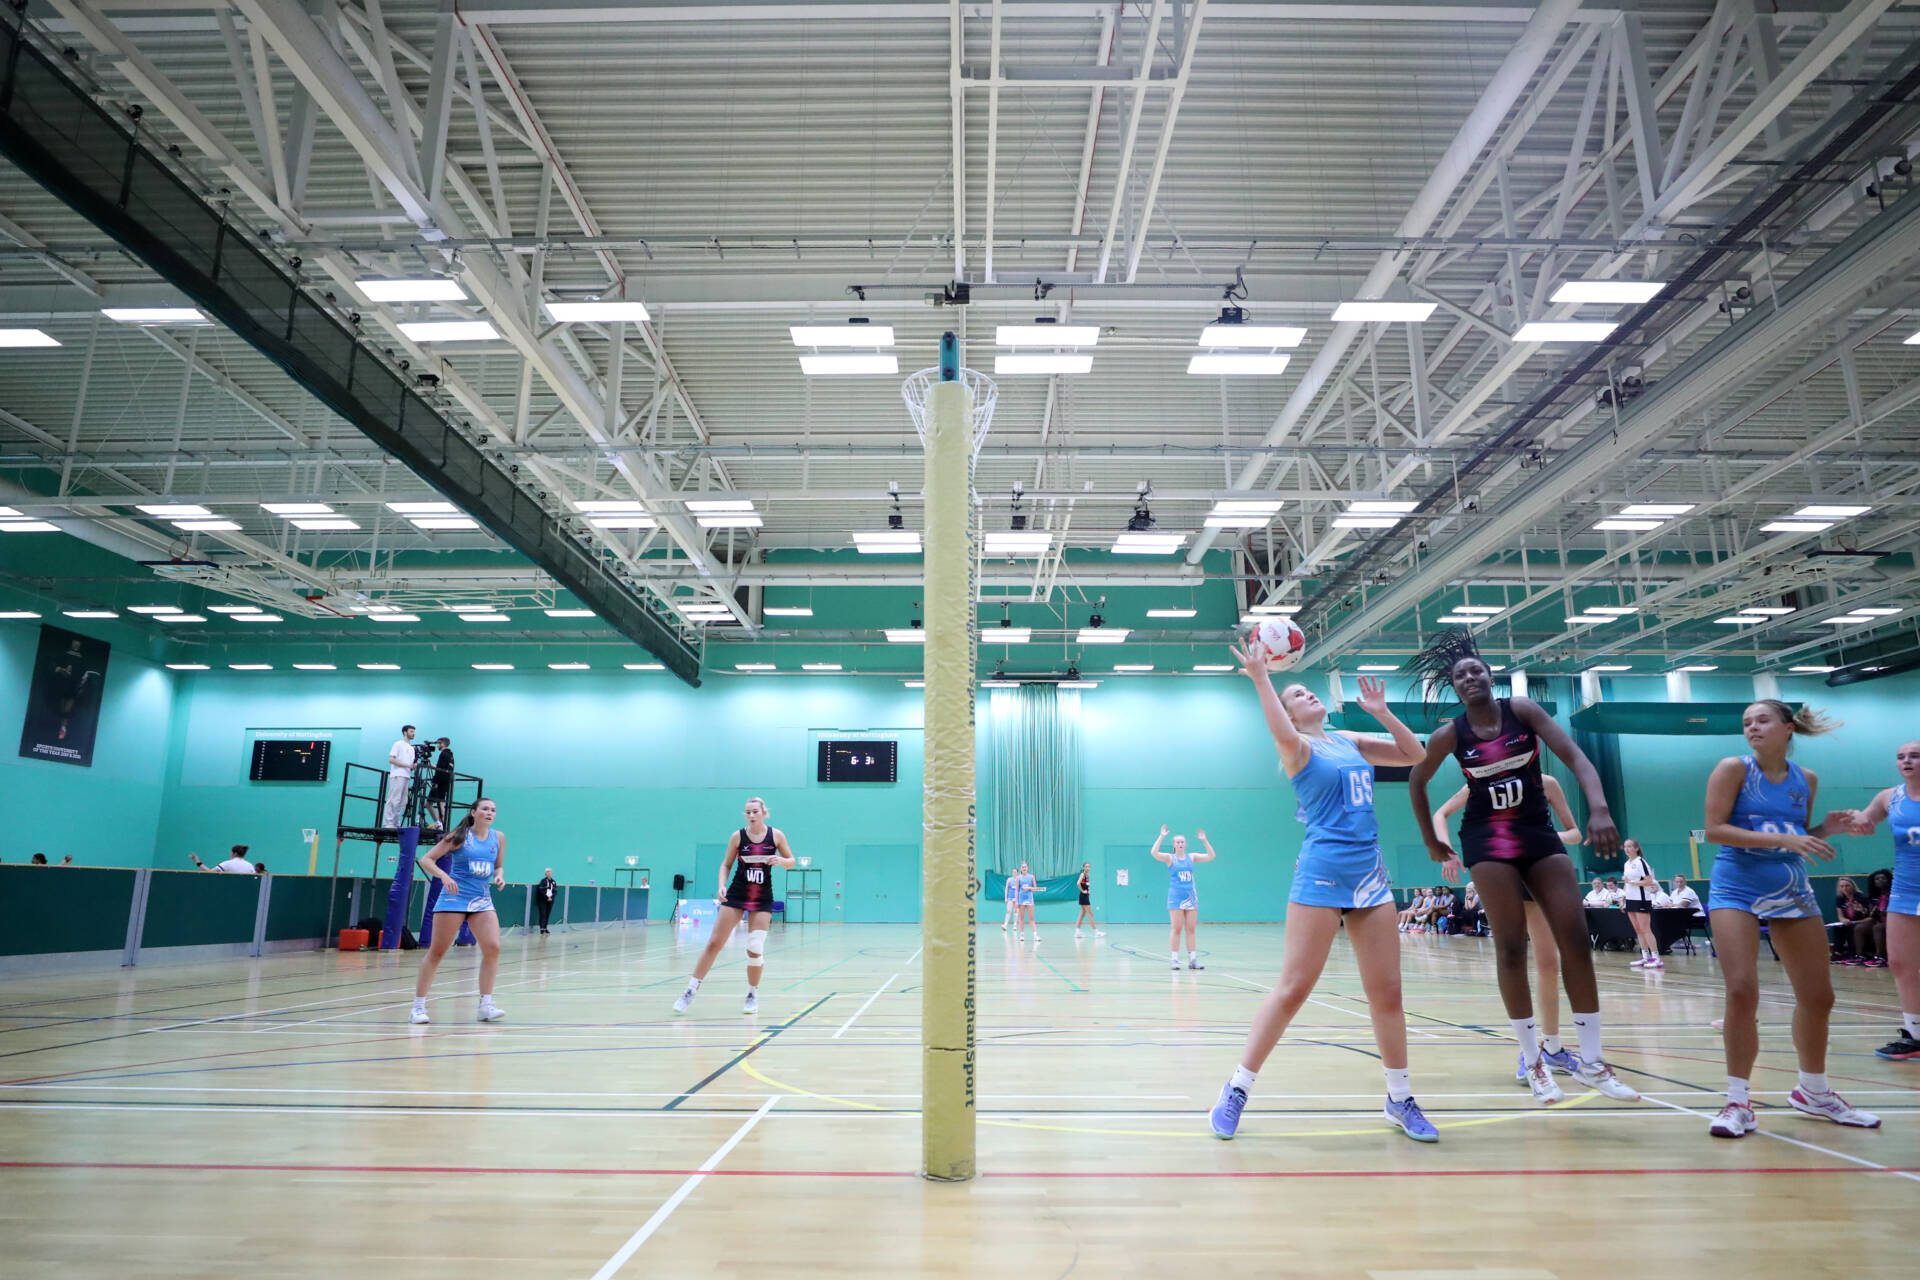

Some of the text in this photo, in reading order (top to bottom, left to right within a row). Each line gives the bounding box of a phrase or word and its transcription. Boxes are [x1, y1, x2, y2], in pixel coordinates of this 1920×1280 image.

[965, 567, 976, 673] Nottingham
[967, 677, 976, 727] Sport
[1348, 769, 1373, 807] GS
[1488, 779, 1523, 809] GD
[746, 869, 764, 885] WD
[963, 1051, 976, 1109] Sport
